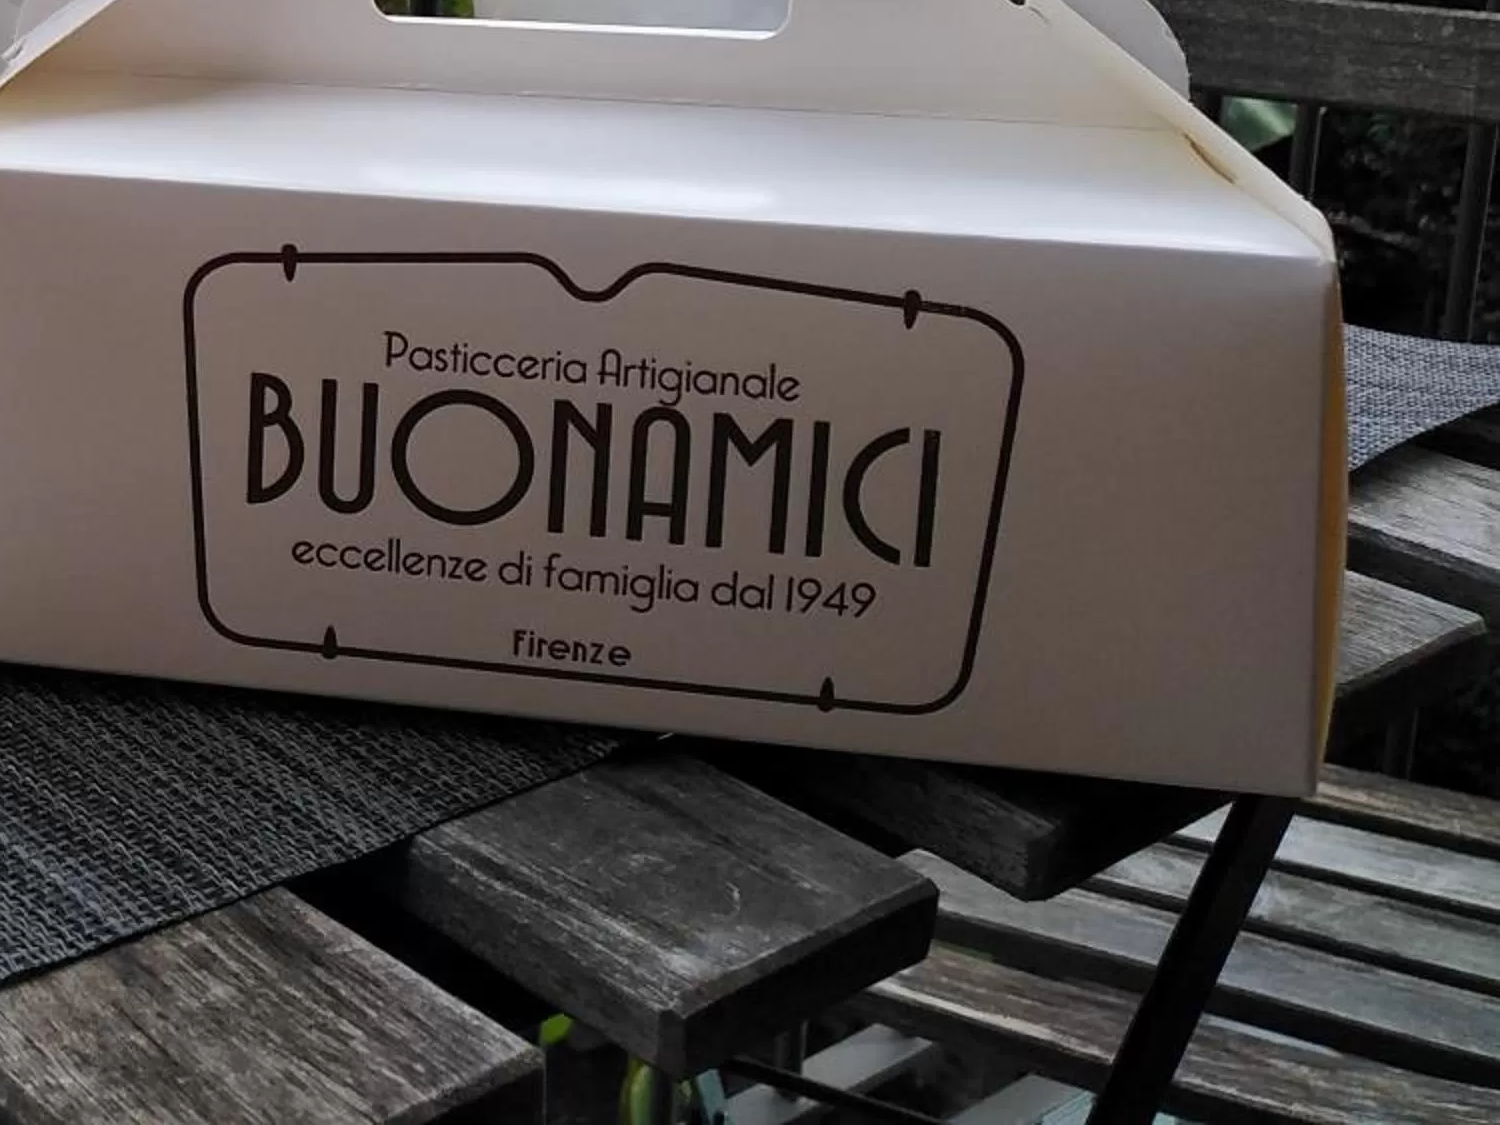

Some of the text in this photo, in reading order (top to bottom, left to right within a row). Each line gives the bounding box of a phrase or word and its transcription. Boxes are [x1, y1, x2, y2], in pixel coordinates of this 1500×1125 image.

[383, 330, 801, 405] Pasticceria Artigianale
[245, 371, 942, 568] BUONAMICI
[291, 537, 878, 620] eccellenze di famiglia dal 1949
[512, 628, 632, 669] Firenze
